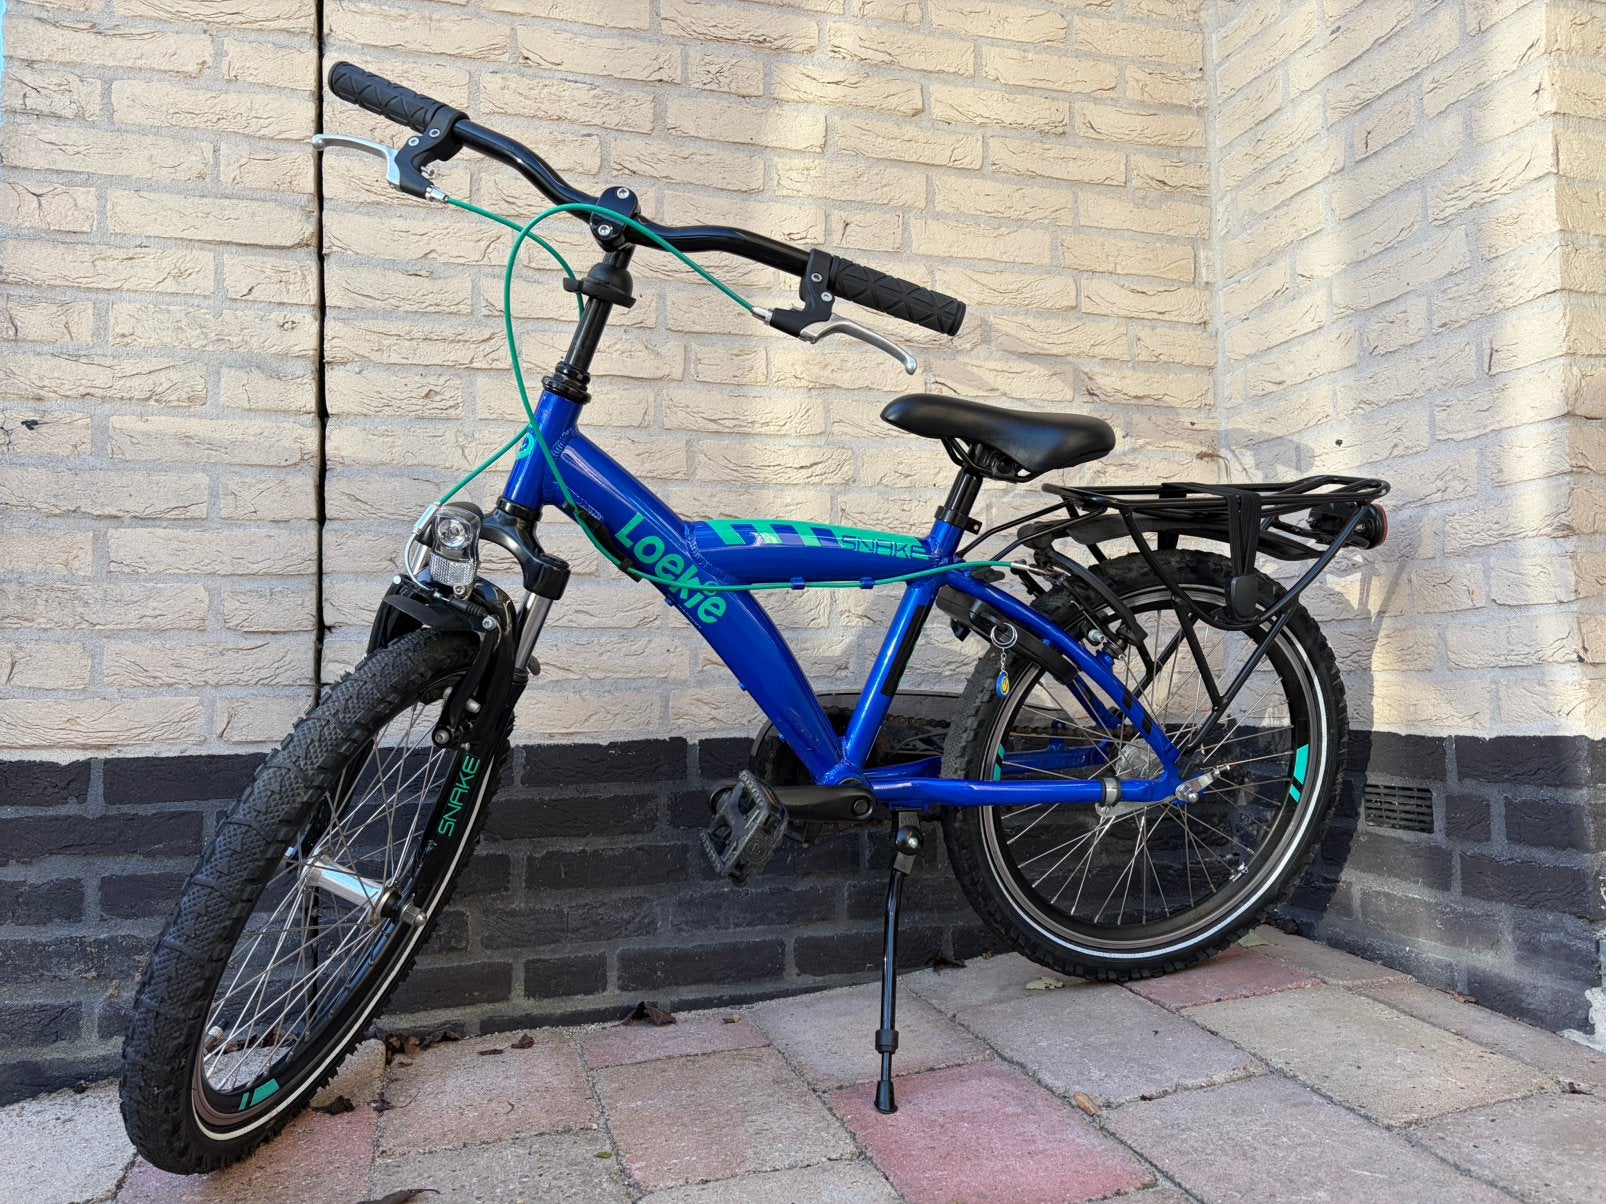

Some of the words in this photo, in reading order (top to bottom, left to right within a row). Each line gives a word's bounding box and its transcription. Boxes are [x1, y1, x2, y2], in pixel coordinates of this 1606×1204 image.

[614, 511, 728, 624] Loekie
[840, 535, 931, 560] SNAKE
[437, 754, 481, 838] SNAKE
